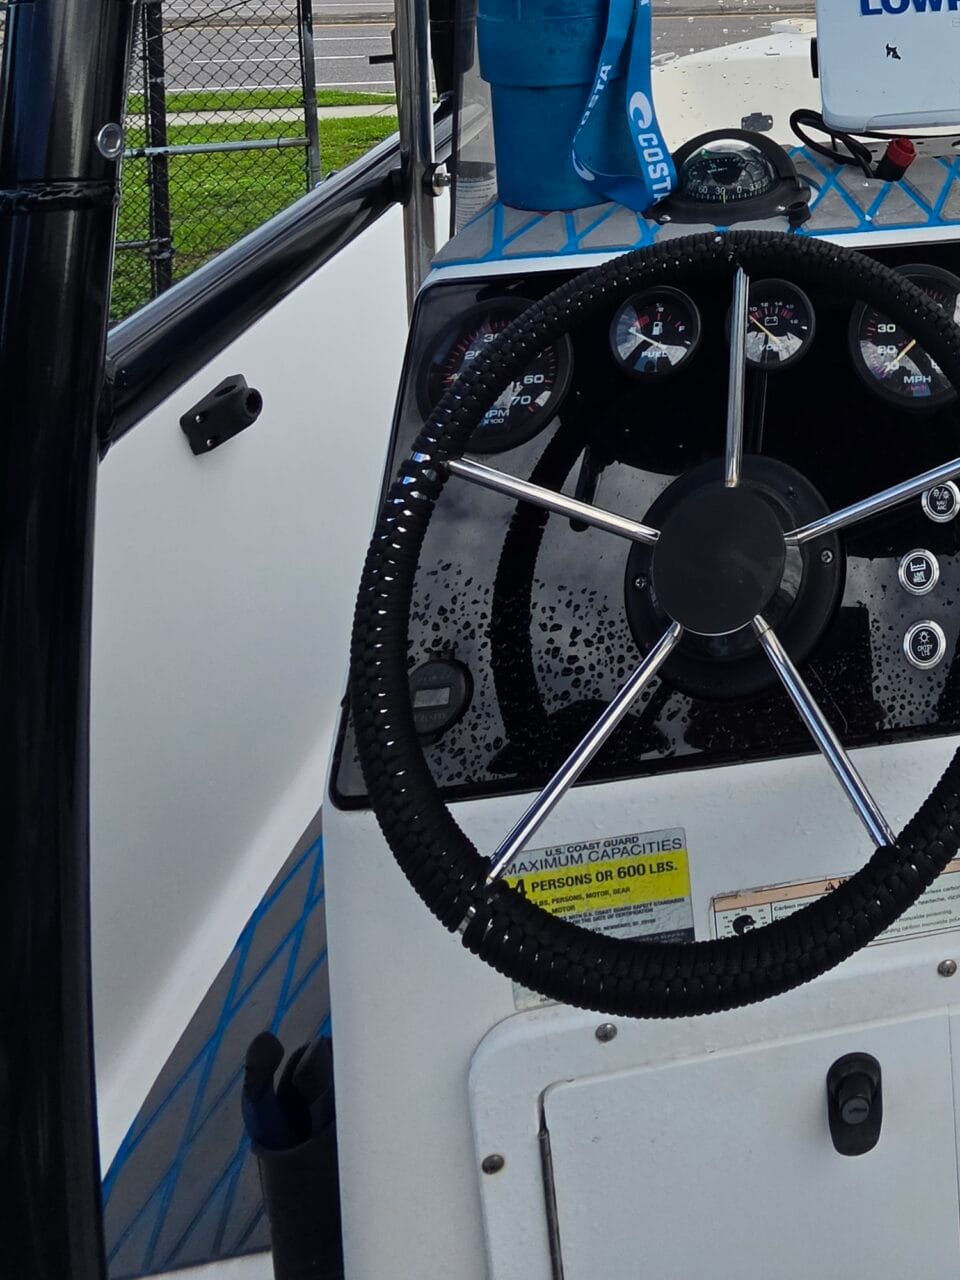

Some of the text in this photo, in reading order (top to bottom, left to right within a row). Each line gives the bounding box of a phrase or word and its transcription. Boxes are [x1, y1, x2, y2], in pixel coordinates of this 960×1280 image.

[715, 186, 726, 195] 30
[877, 324, 896, 333] 30
[523, 374, 544, 384] 60
[903, 375, 932, 384] MPH
[511, 395, 532, 406] 70
[545, 836, 640, 857] U.S. COAST GUARD
[504, 837, 682, 877] MAXIMUM CAPACITIES
[531, 872, 592, 893] PERSONS
[595, 868, 613, 883] OR
[618, 864, 646, 879] 600
[649, 860, 678, 875] LBS.
[552, 893, 585, 905] PERSONS,
[586, 890, 612, 900] MOTOR,
[613, 887, 631, 895] GEAR
[552, 905, 575, 914] MOTOR
